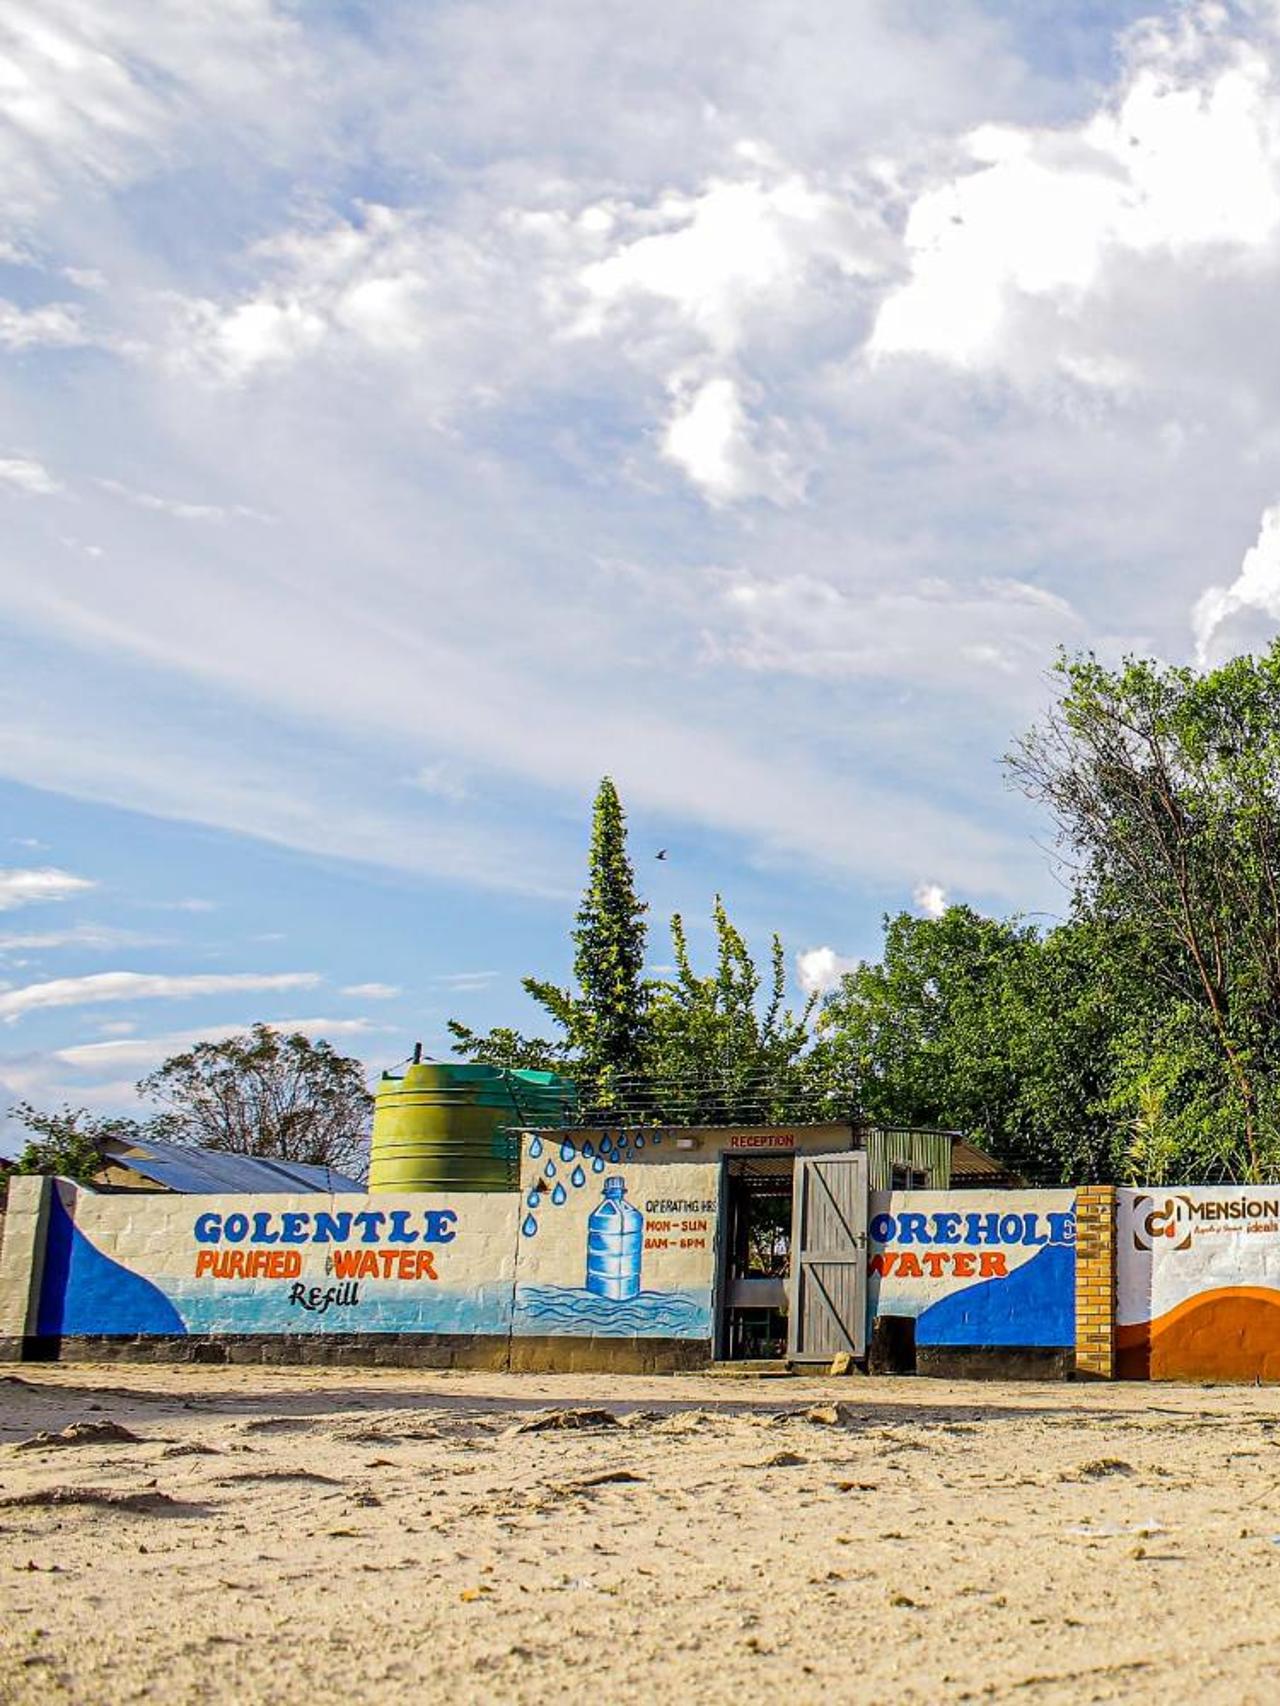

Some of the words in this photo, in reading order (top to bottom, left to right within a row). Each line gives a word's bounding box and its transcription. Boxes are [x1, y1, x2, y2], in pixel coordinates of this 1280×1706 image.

[730, 1135, 795, 1148] RECEPTION
[645, 1199, 700, 1213] OPERATING
[194, 1210, 458, 1244] GOLENTLE
[869, 1213, 1076, 1245] OREHOLE
[195, 1250, 302, 1279] PURIFIED
[332, 1250, 438, 1280] WATER
[868, 1252, 1008, 1278] WATER
